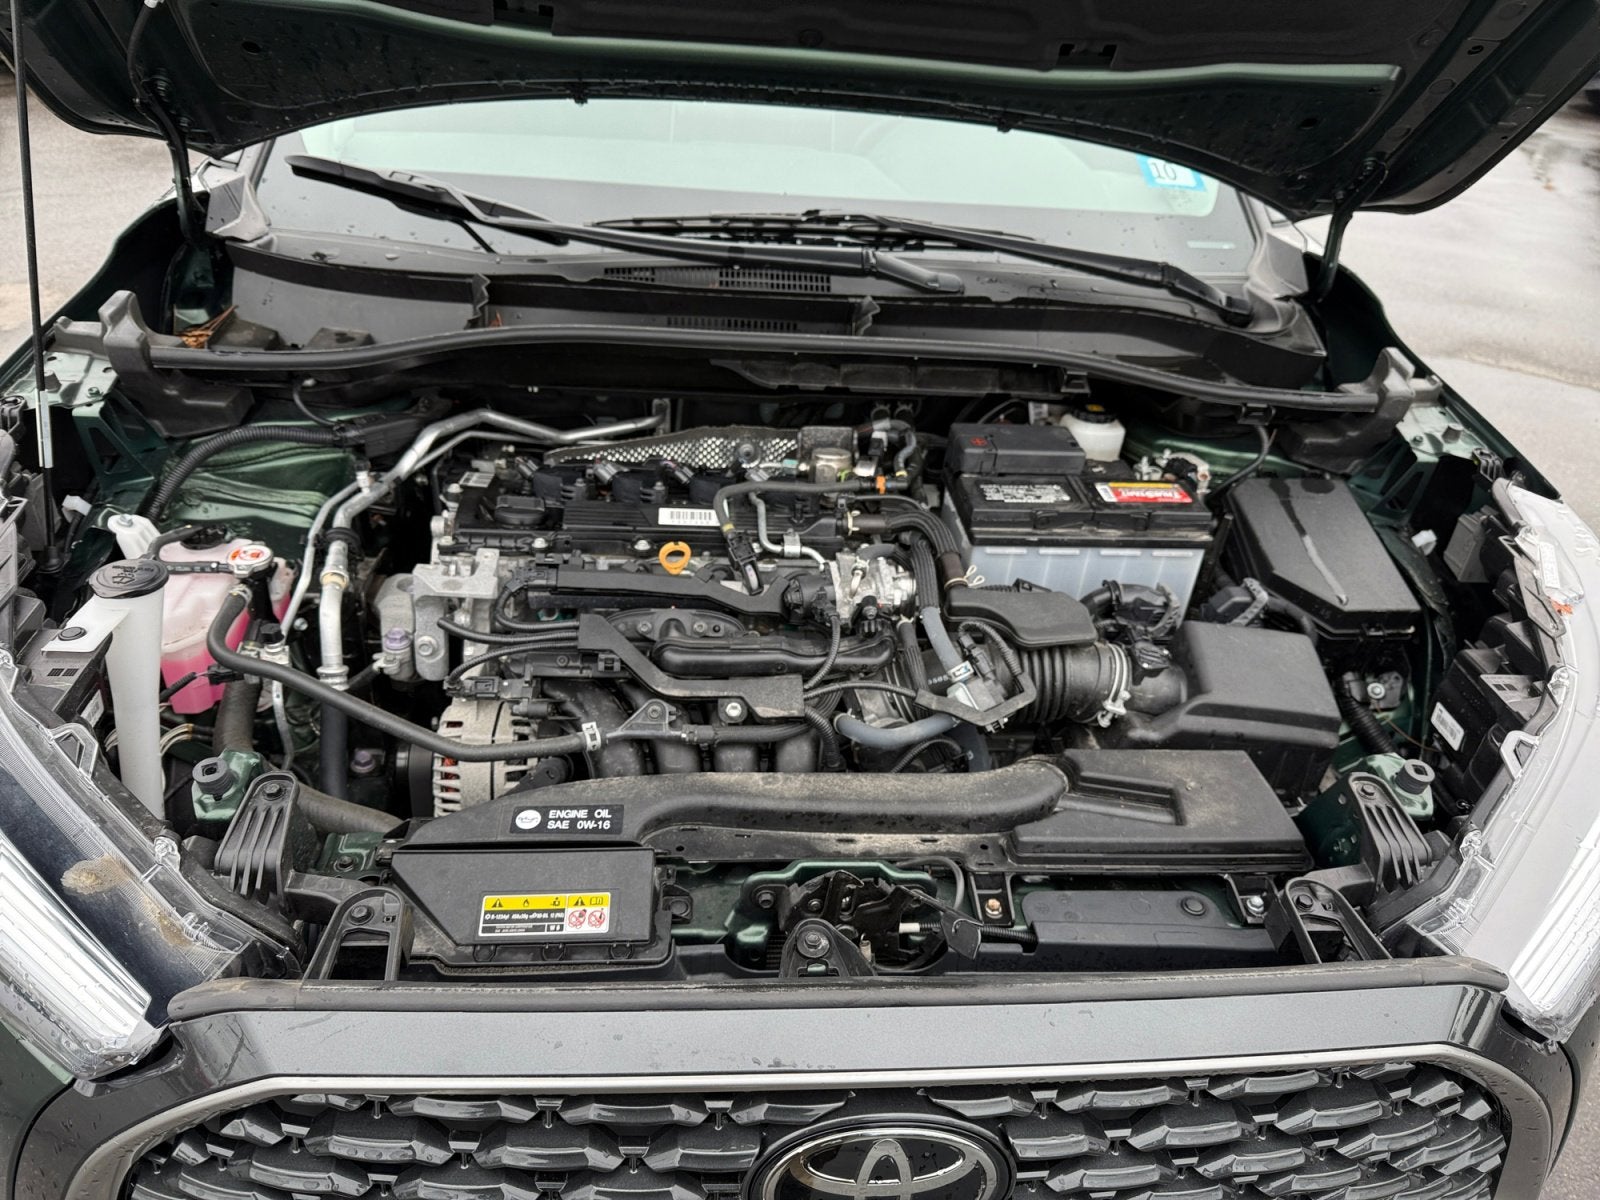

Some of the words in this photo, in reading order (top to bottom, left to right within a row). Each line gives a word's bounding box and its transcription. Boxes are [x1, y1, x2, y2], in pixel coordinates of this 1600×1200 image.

[548, 809, 589, 819] ENGINE
[594, 808, 612, 819] OIL
[547, 820, 570, 830] SAE
[576, 820, 611, 830] 0W-16
